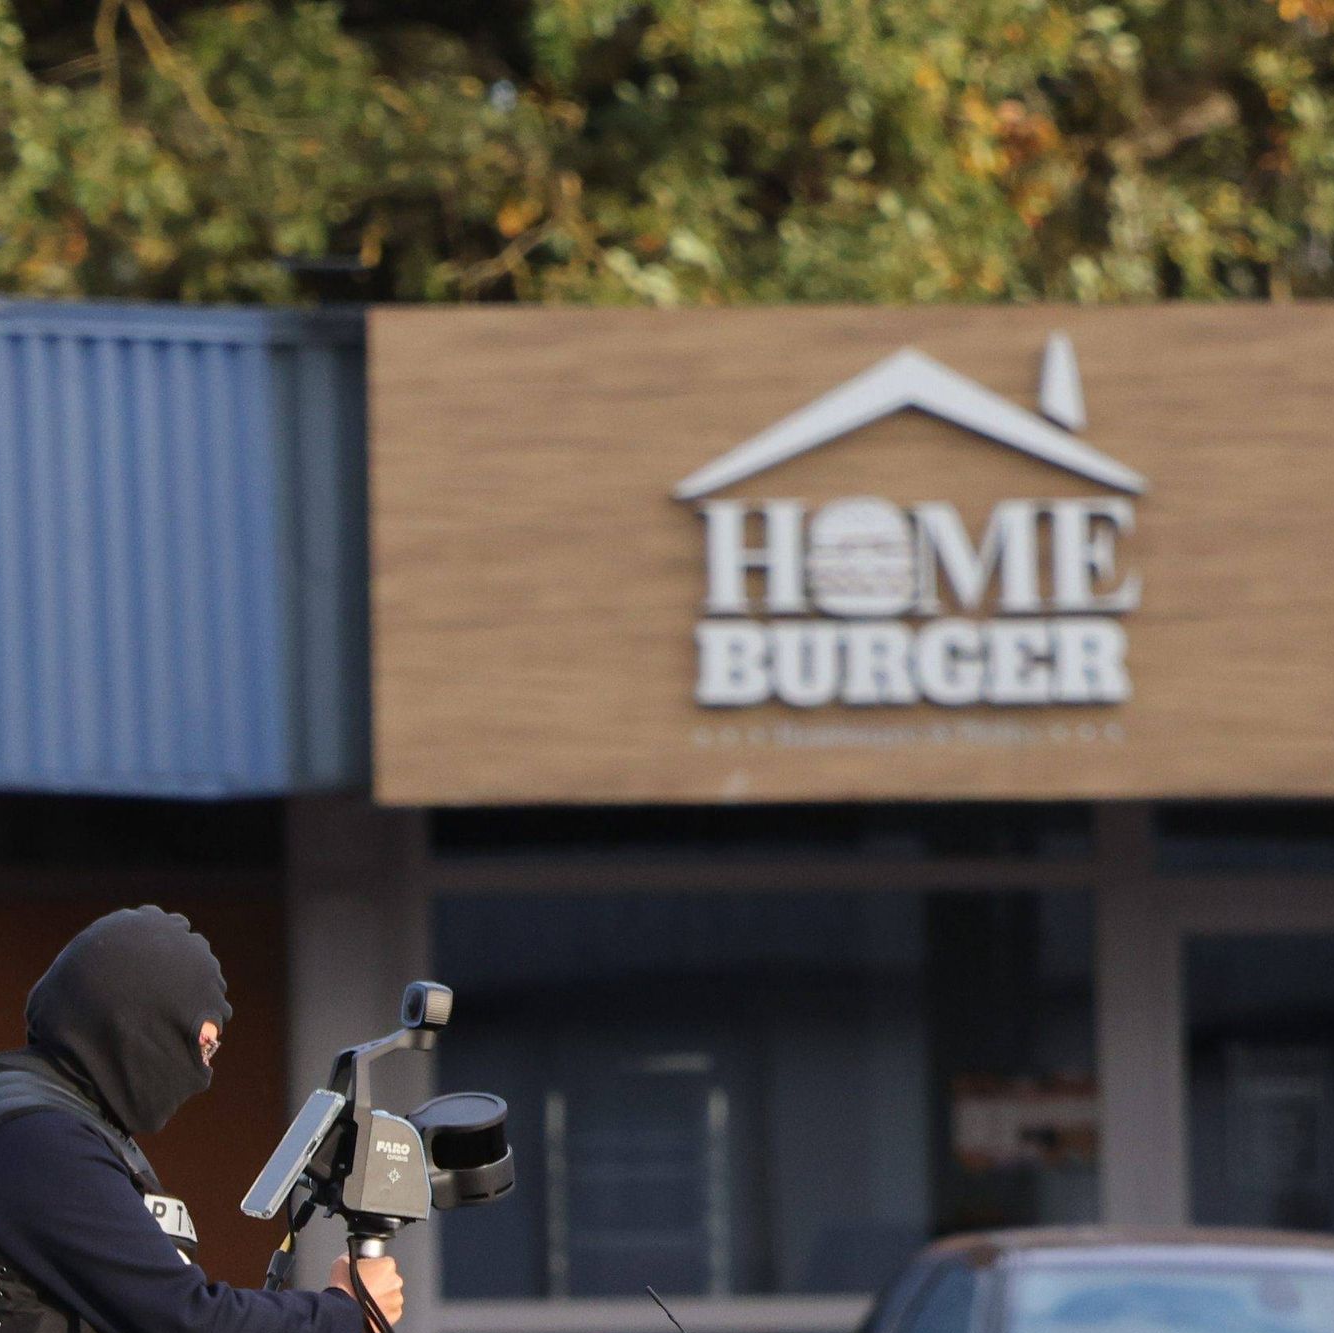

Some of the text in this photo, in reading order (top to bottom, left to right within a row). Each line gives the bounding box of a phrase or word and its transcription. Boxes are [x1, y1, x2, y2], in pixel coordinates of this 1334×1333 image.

[695, 619, 1129, 705] BURGER
[376, 1140, 410, 1155] FARO
[152, 1201, 192, 1235] PT
